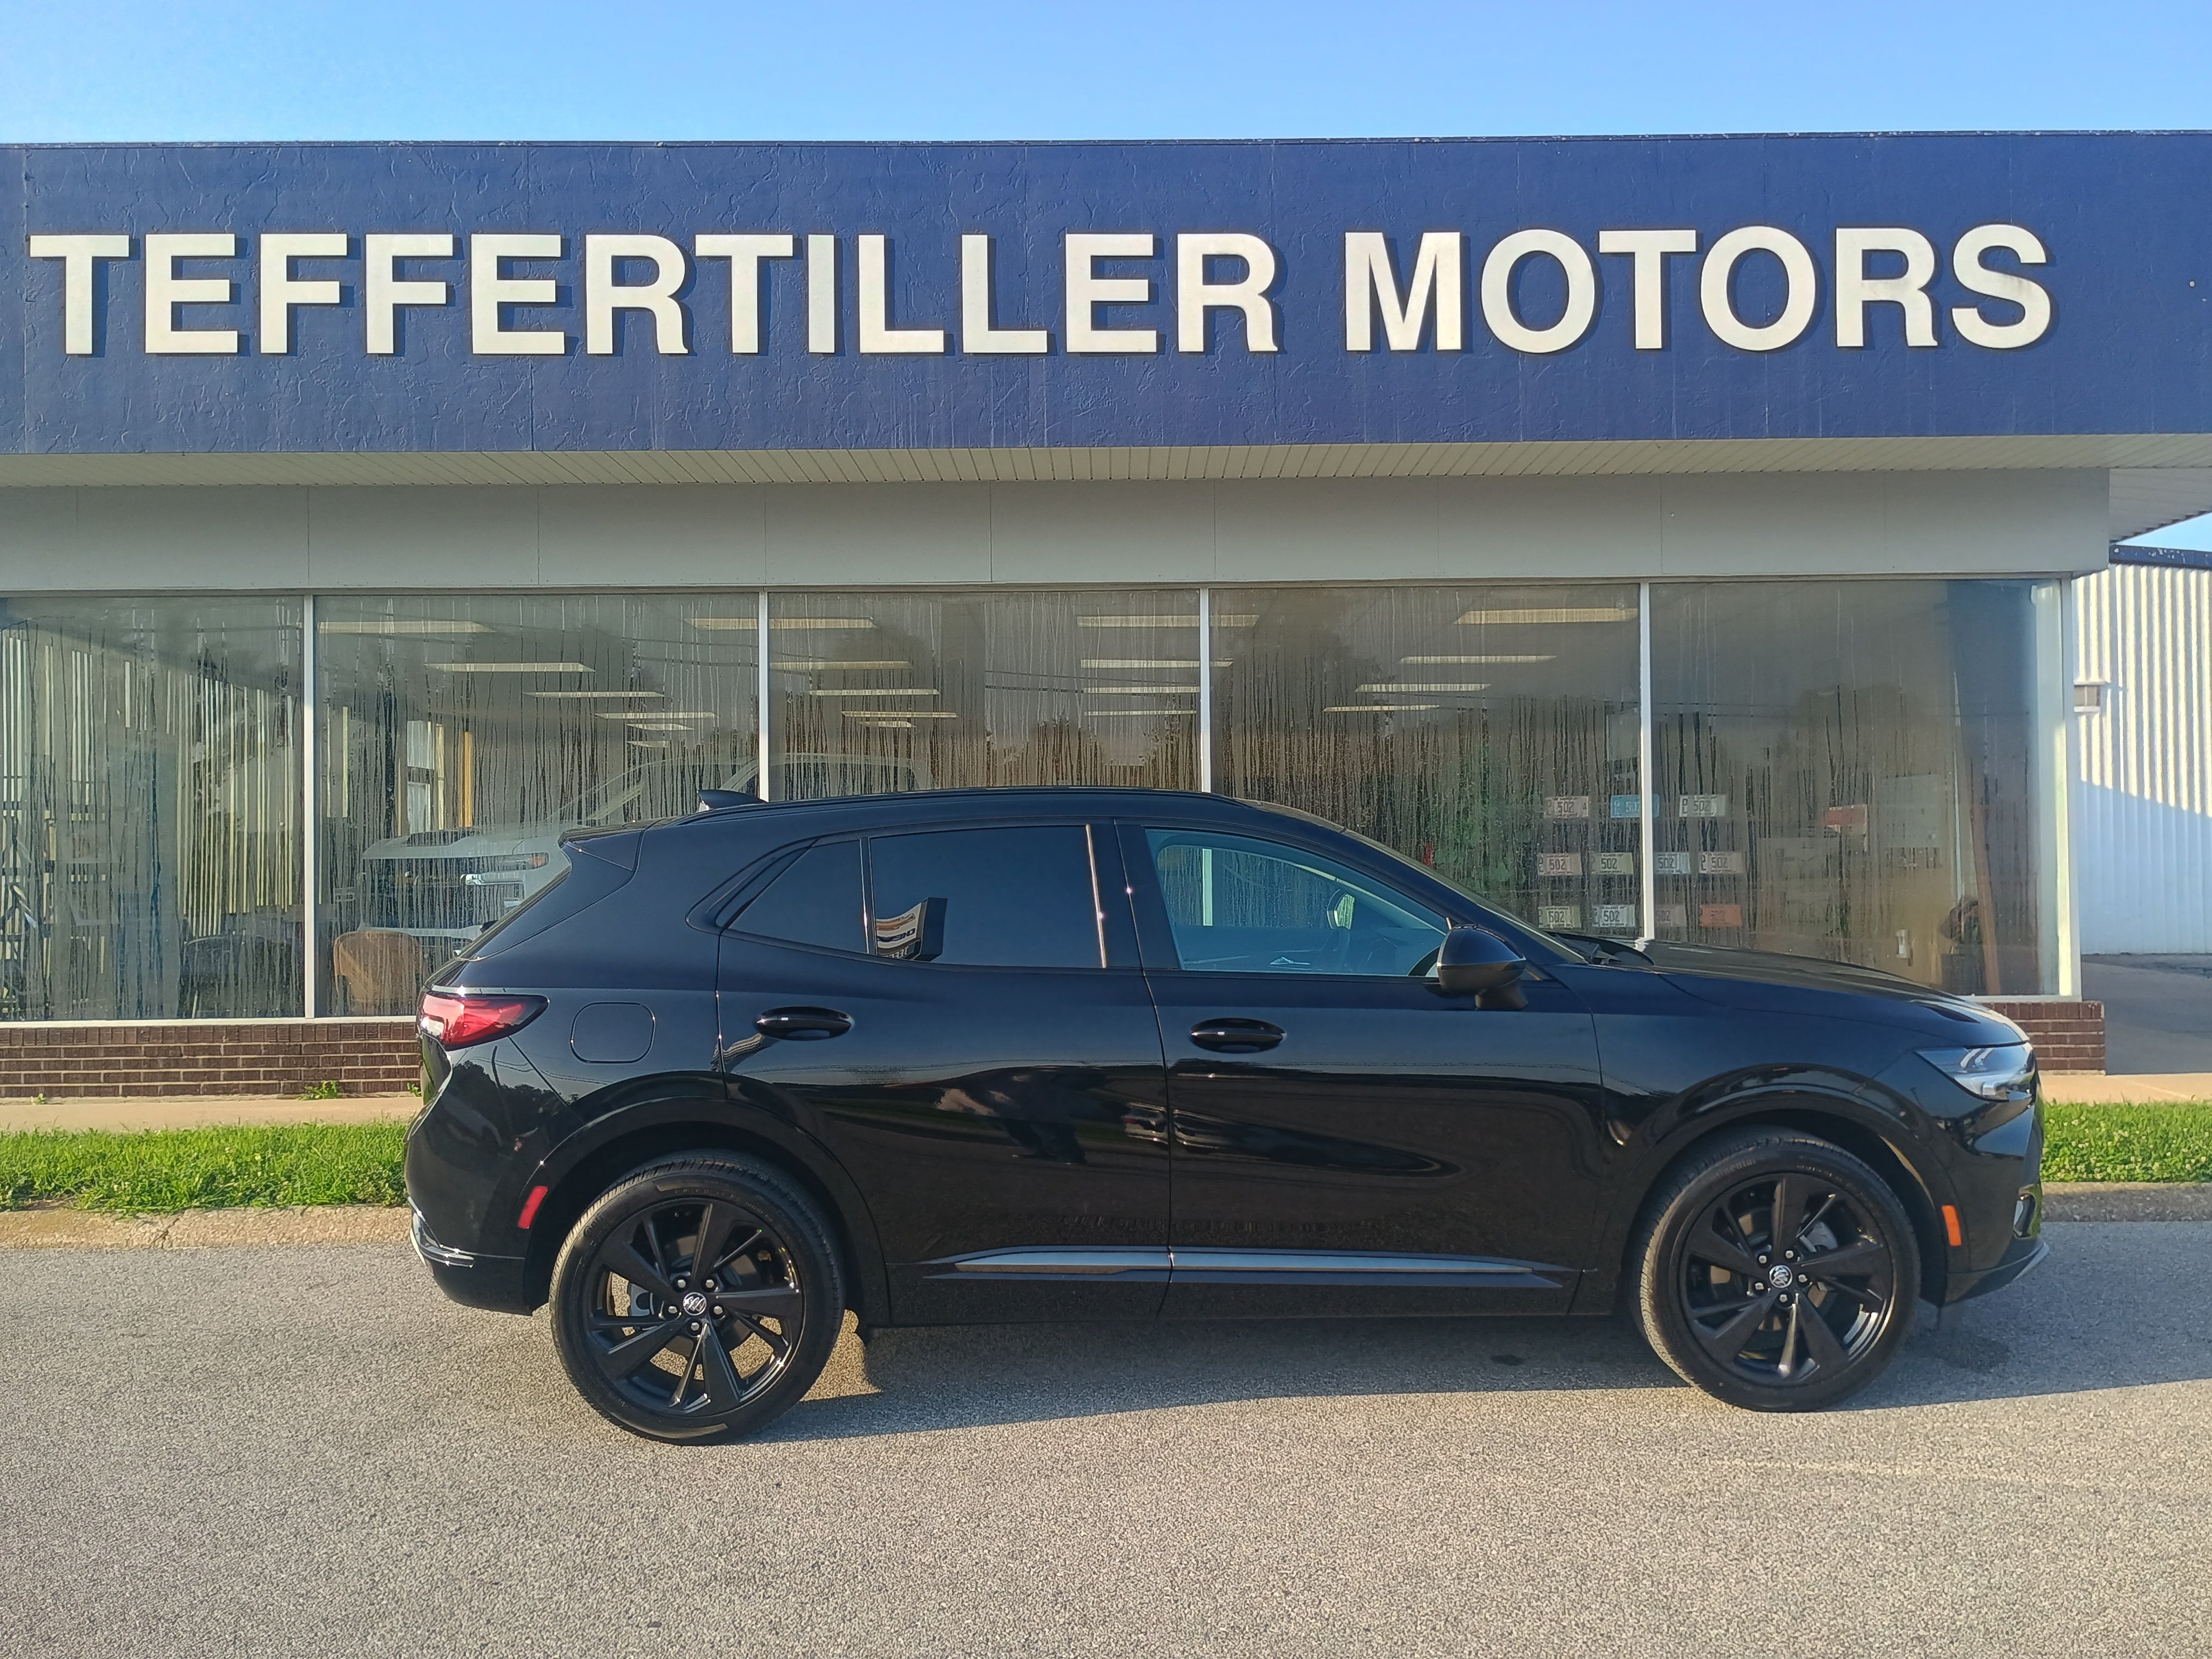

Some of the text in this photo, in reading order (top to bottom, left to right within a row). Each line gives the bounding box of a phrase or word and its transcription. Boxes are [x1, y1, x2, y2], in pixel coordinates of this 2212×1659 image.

[30, 225, 2052, 354] TEFFERTILLER MOTORS
[1557, 801, 1574, 813] 502
[1694, 800, 1709, 812] 502
[1549, 859, 1566, 870] 502
[1601, 858, 1617, 869] 502
[1658, 858, 1675, 868] 502
[1711, 857, 1728, 868] 502
[1603, 911, 1620, 922] 502
